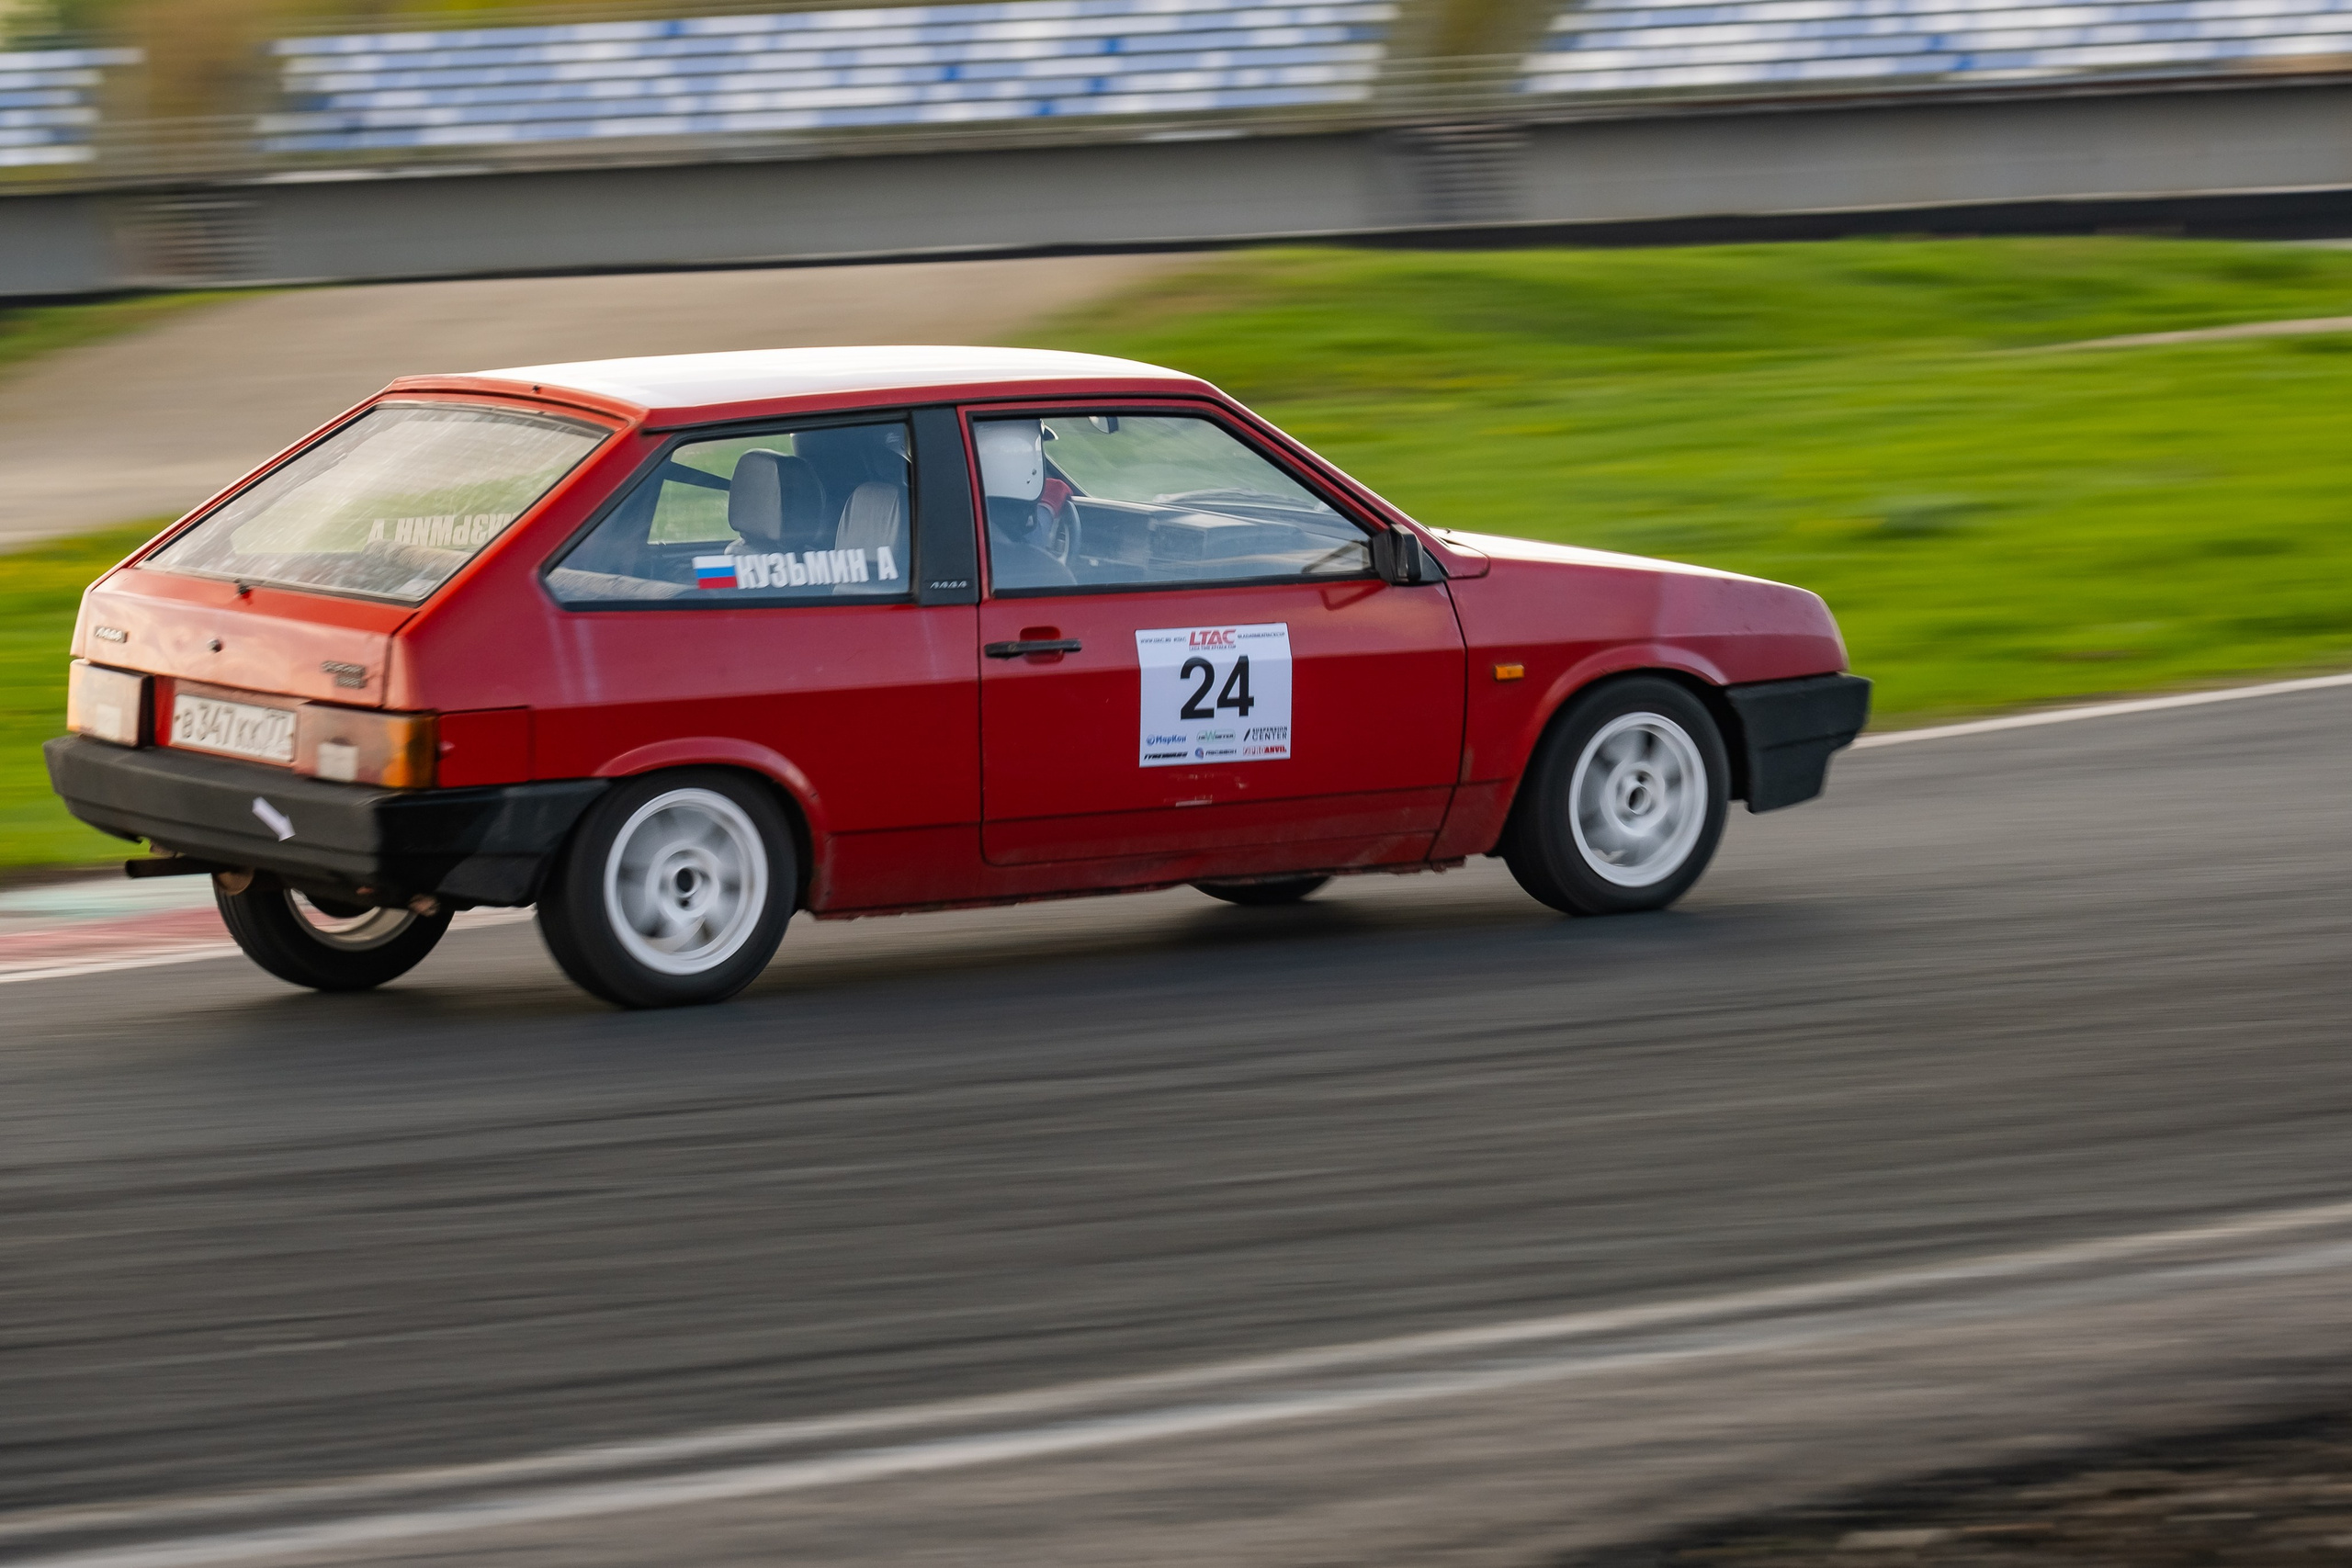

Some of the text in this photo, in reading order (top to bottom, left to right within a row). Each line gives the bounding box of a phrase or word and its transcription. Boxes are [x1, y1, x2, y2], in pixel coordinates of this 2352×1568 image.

[737, 546, 899, 590] КУЗЬМИН А
[1189, 628, 1237, 646] LTAC
[1180, 655, 1255, 720] 24
[1251, 732, 1287, 741] CENTER
